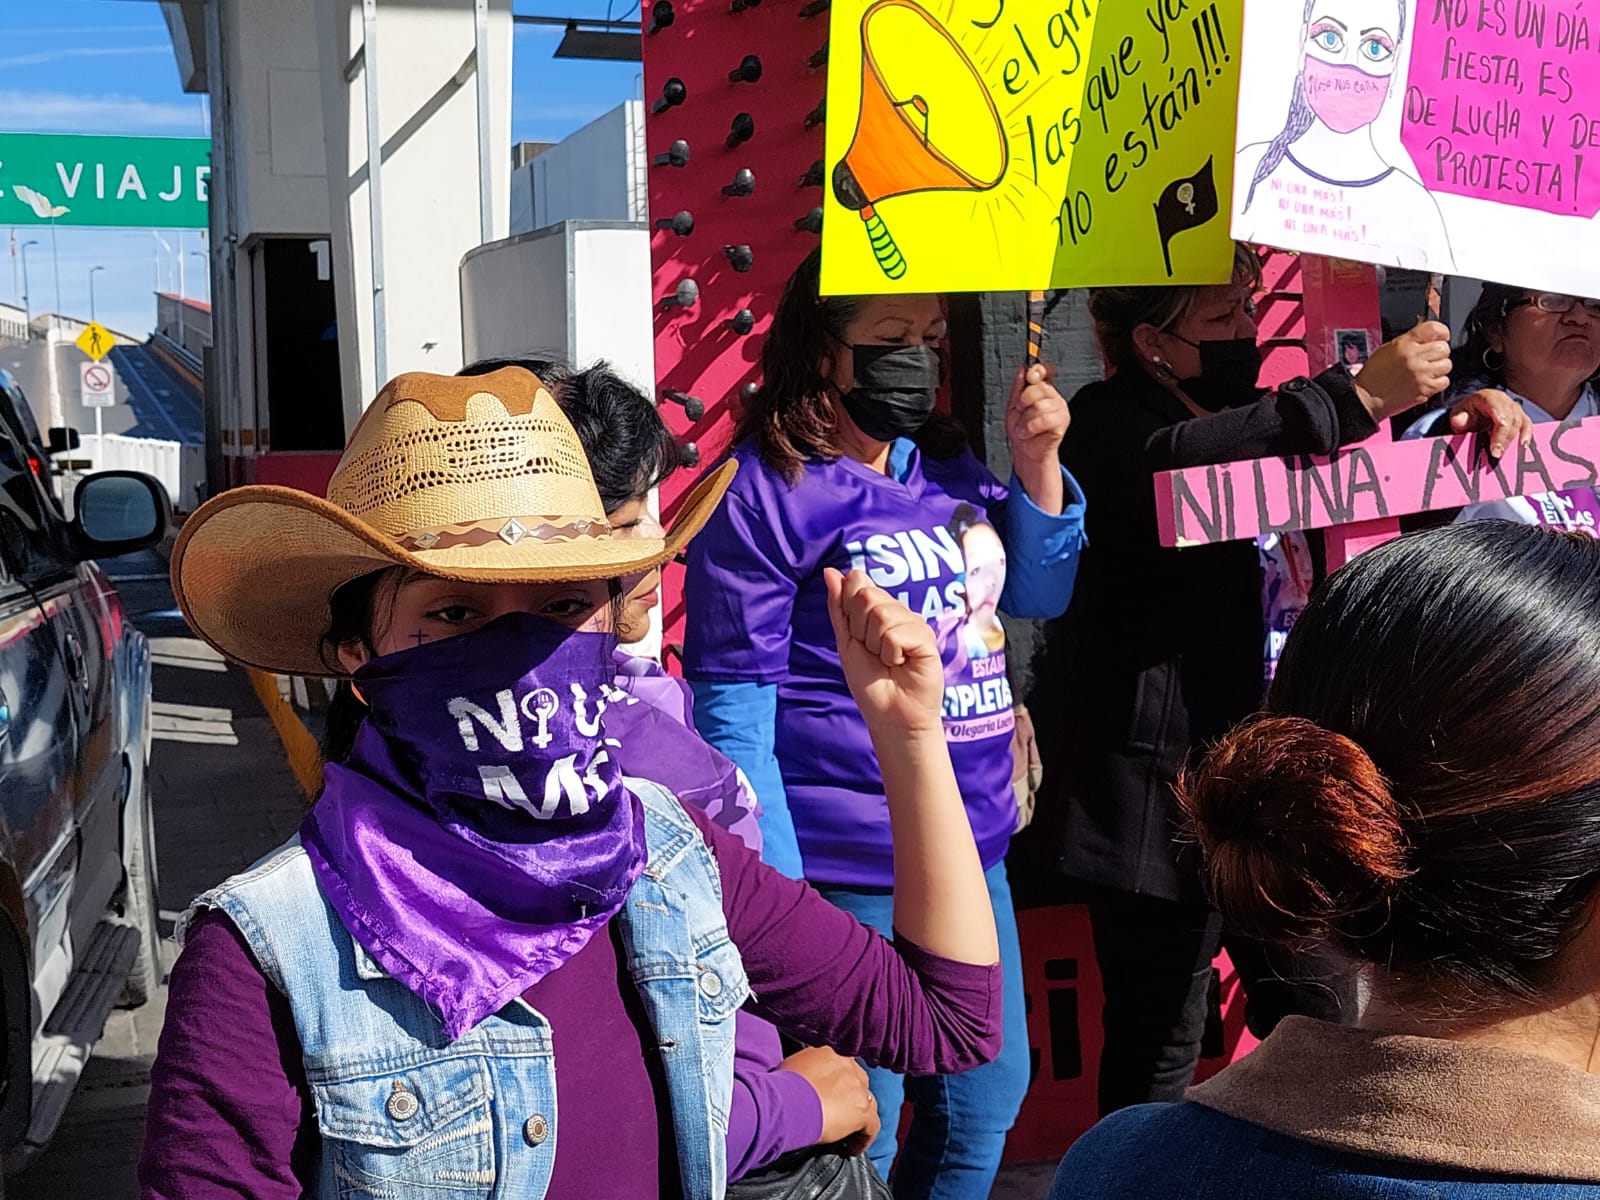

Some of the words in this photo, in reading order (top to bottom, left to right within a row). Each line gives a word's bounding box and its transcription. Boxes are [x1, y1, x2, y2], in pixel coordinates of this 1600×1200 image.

[1432, 0, 1468, 32] NO
[1477, 0, 1507, 36] ES
[1515, 0, 1546, 49] UN
[1556, 2, 1589, 54] DÍA
[1003, 24, 1040, 95] el
[1539, 61, 1574, 104] ES
[1026, 107, 1081, 186] las
[1087, 36, 1141, 134] que
[1404, 85, 1438, 127] DE
[1451, 95, 1520, 146] LUCHA
[1542, 114, 1555, 149] Y
[1569, 112, 1600, 150] DE
[1426, 136, 1583, 212] PROTESTA!
[1051, 190, 1092, 247] no
[308, 240, 330, 280] 1
